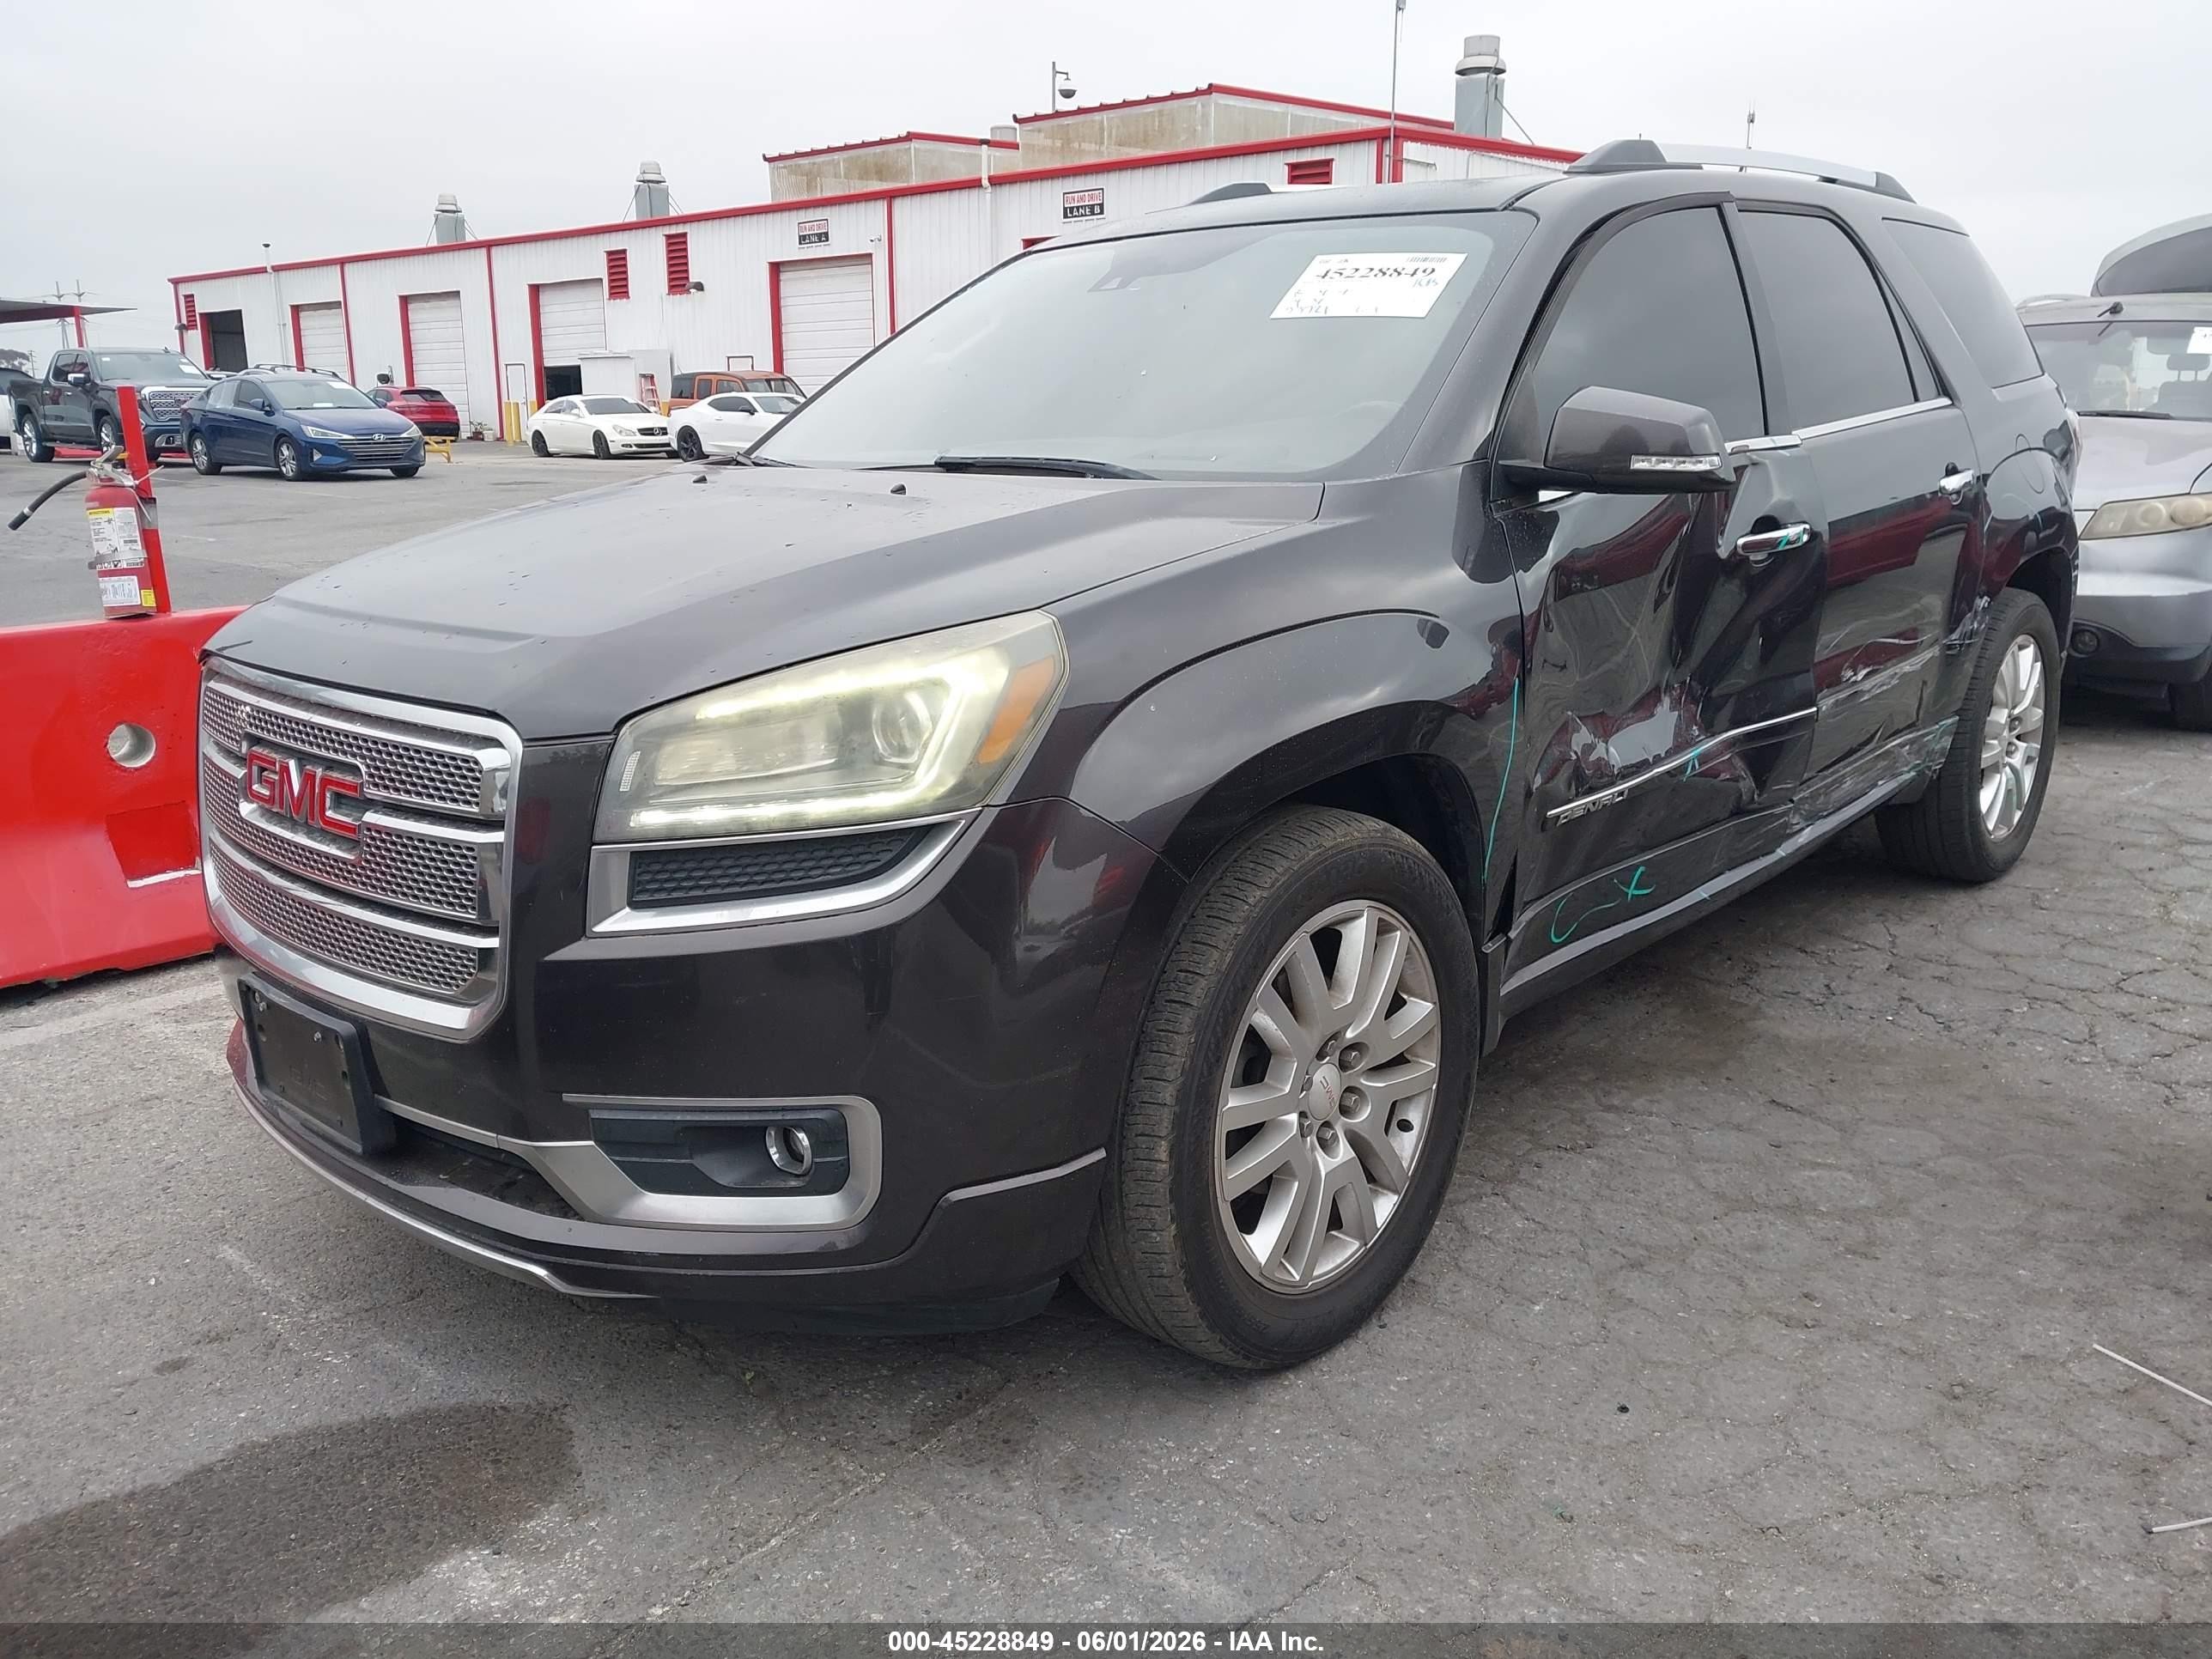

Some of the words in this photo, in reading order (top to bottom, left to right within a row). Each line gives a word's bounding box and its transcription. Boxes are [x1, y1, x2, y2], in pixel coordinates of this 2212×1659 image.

[1065, 195, 1075, 205] RUN
[1076, 193, 1086, 204] AND
[1087, 191, 1102, 204] DRIVE
[1066, 206, 1091, 217] LANE
[1094, 204, 1101, 214] B
[800, 234, 819, 244] LANE
[821, 233, 826, 241] A
[1316, 266, 1437, 280] 45228849
[246, 745, 364, 841] GMC
[1556, 788, 1629, 827] DENALI
